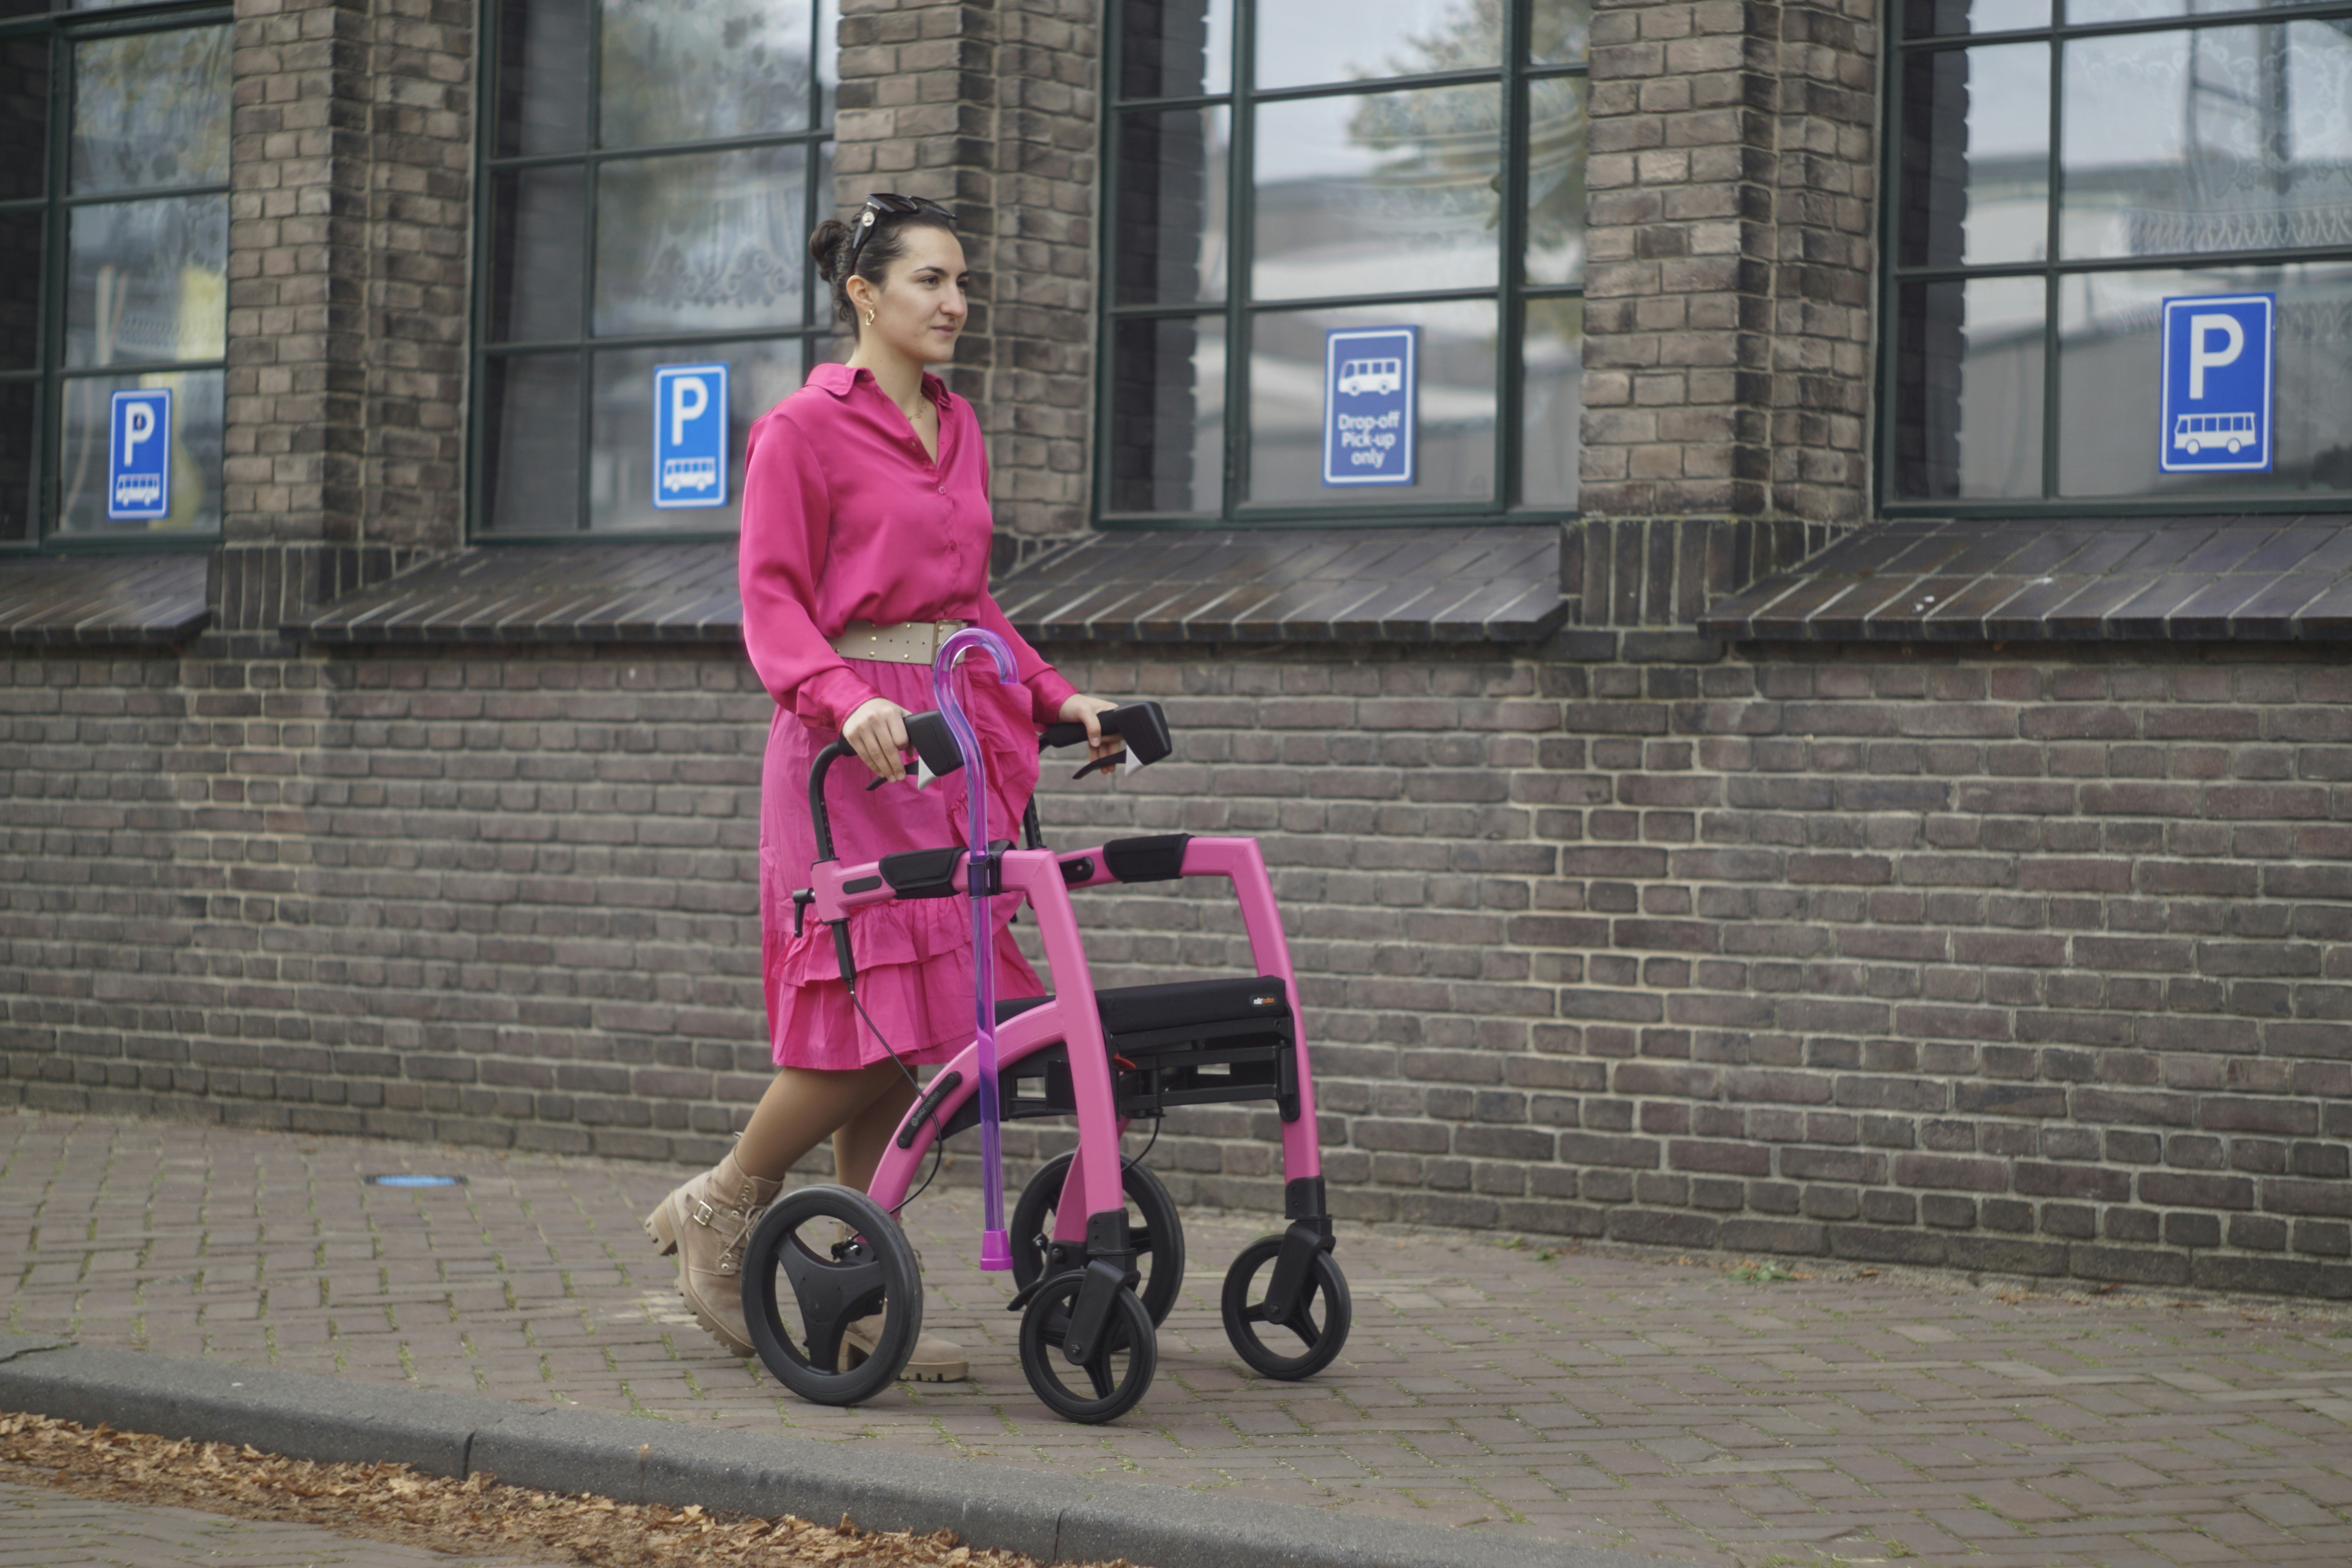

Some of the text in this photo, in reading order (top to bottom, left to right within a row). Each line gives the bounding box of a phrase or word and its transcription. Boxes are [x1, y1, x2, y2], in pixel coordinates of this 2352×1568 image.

[2189, 314, 2244, 399] P
[672, 377, 708, 446] P
[1338, 410, 1401, 431] Drop-off
[124, 402, 155, 466] P
[1341, 431, 1396, 450] Pick-up
[1351, 448, 1385, 468] only
